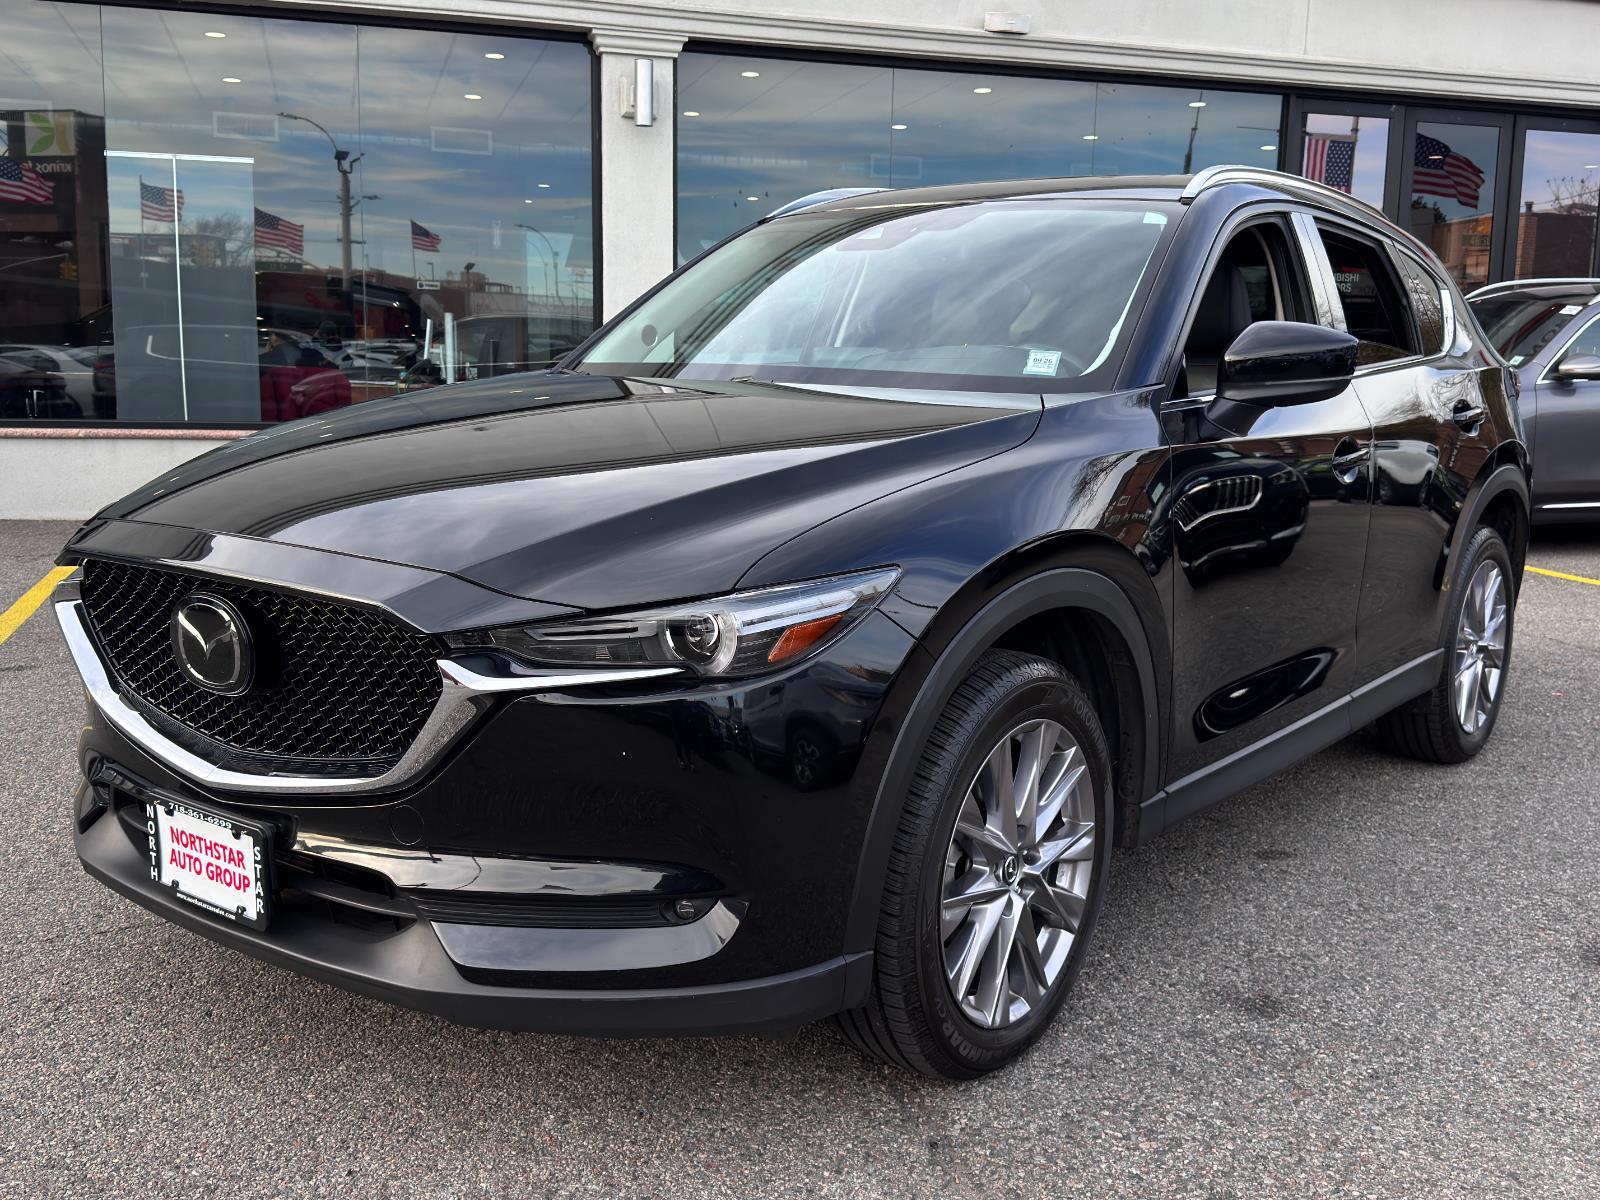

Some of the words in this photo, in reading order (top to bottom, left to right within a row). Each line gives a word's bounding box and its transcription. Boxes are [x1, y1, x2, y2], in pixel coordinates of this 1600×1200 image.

[169, 802, 232, 829] 718-361-6299
[146, 803, 158, 881] NORTH
[169, 825, 246, 870] NORTHSTAR
[169, 847, 203, 876] AUTO
[205, 861, 251, 893] GROUP
[253, 846, 265, 914] STAR
